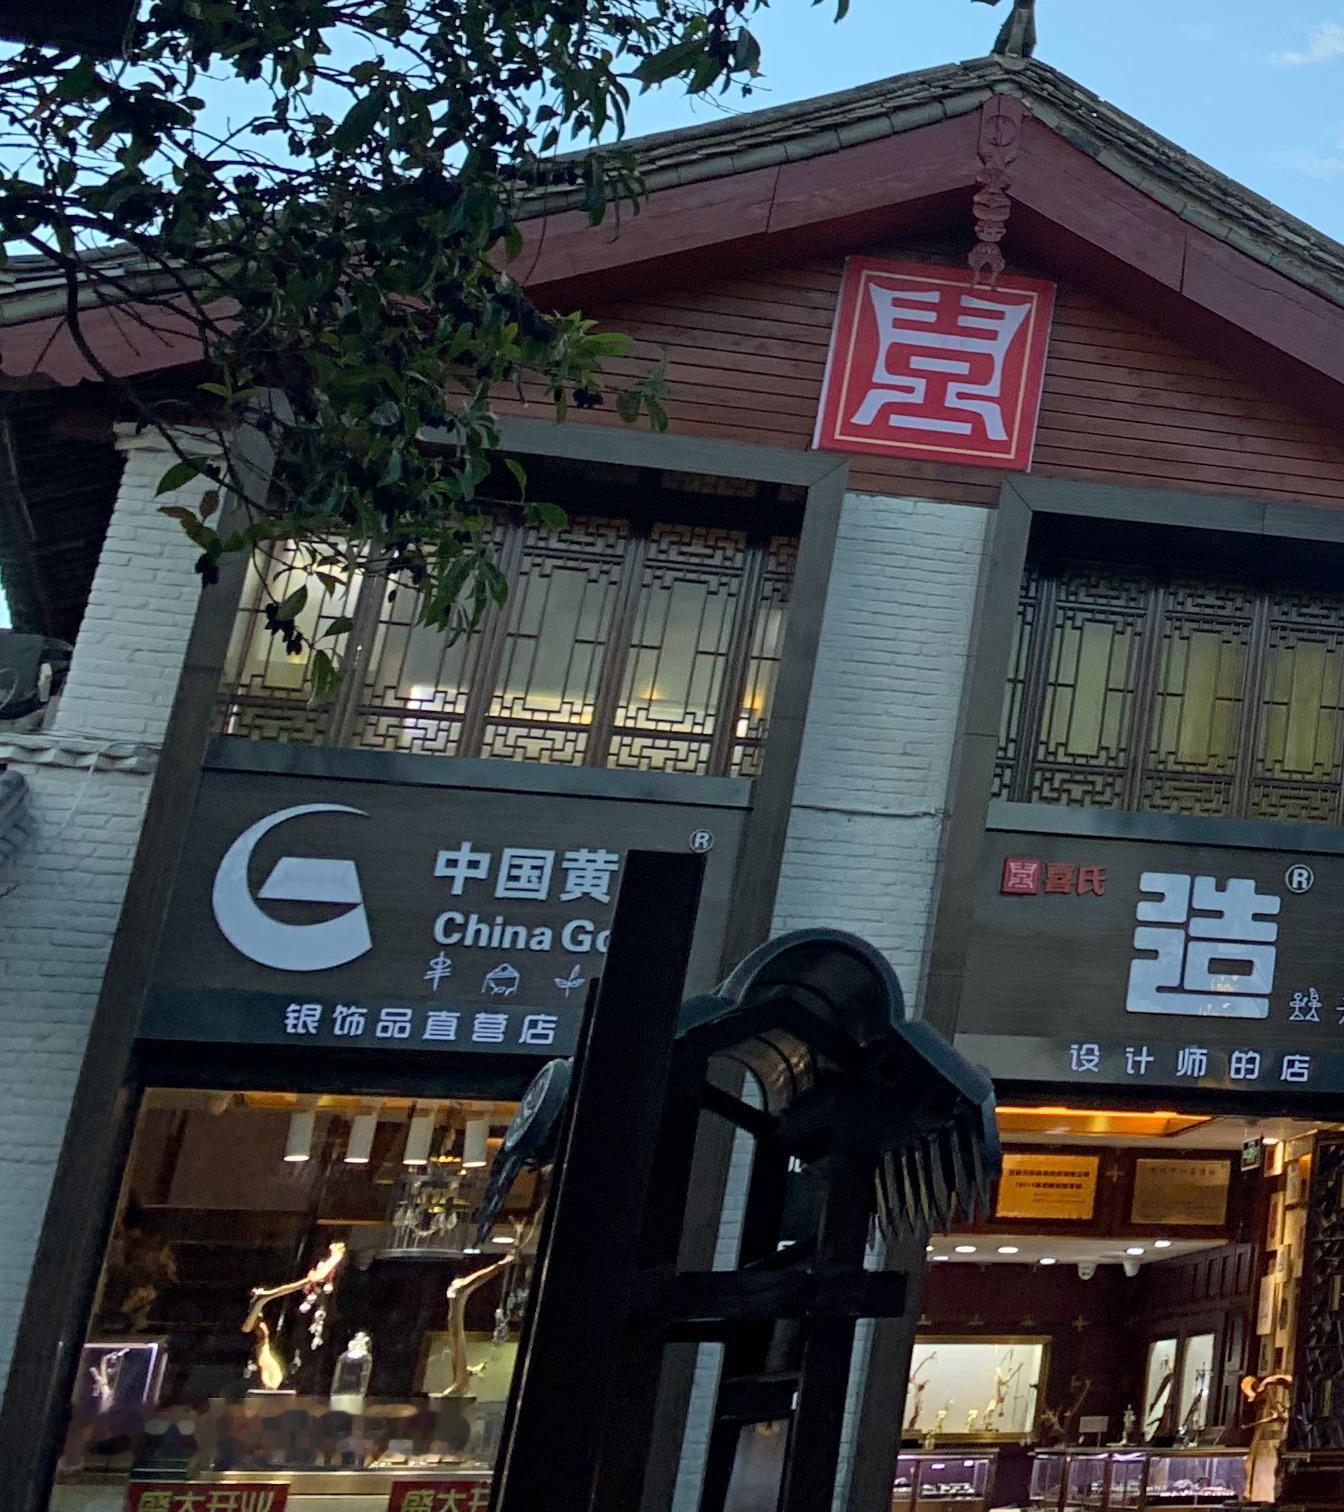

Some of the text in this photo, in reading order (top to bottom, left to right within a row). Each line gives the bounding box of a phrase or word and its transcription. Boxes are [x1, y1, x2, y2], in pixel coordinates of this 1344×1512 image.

[433, 910, 552, 952] China
[284, 1002, 559, 1046] 银饰品直营店
[1069, 1043, 1311, 1083] 设计师的店
